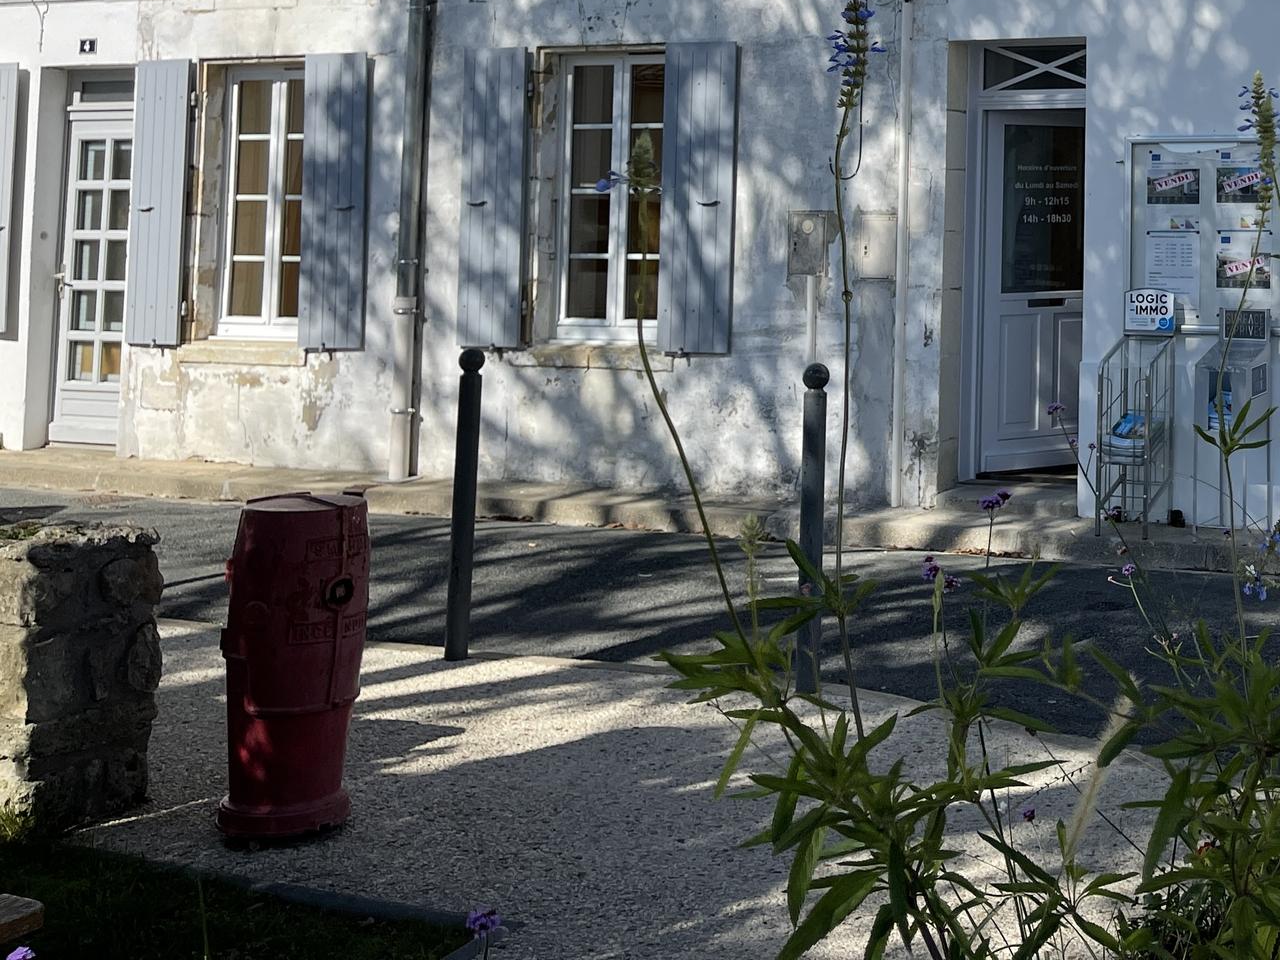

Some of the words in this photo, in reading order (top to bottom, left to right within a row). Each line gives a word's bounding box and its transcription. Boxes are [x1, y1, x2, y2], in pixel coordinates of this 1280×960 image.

[1015, 181, 1024, 189] du
[1025, 181, 1045, 189] Lundi
[1055, 181, 1080, 189] Samedi
[1156, 172, 1194, 189] VENDU
[1025, 196, 1036, 206] 9h
[1044, 196, 1070, 206] 12h15
[1022, 214, 1038, 223] 14h
[1047, 214, 1072, 223] 18h30
[1130, 294, 1168, 304] LOGIC
